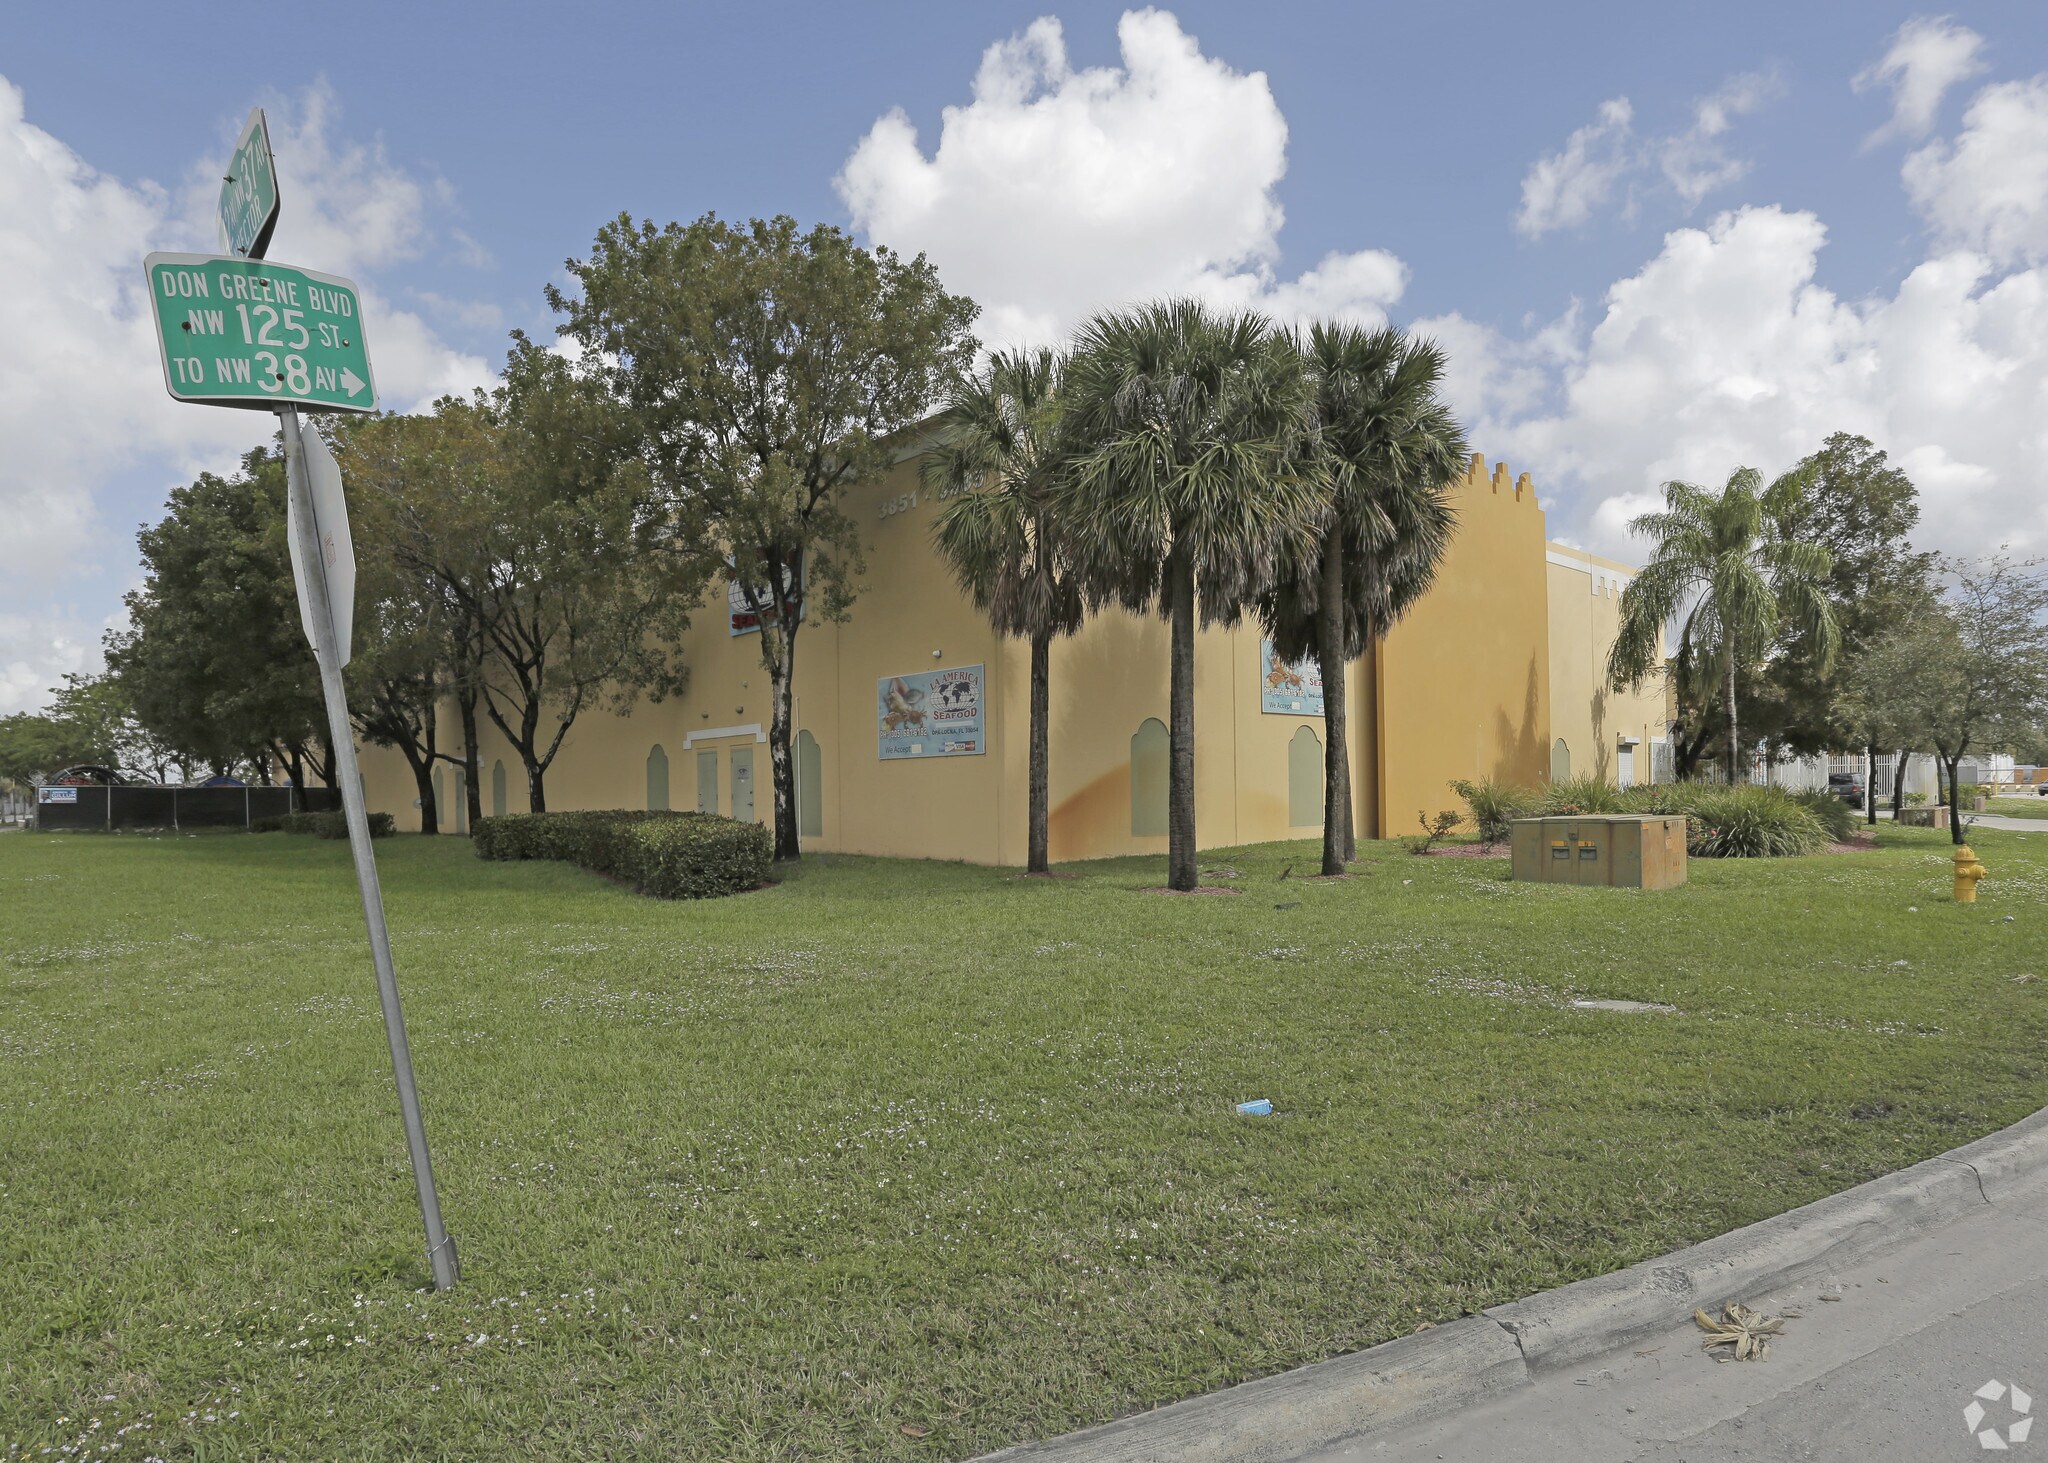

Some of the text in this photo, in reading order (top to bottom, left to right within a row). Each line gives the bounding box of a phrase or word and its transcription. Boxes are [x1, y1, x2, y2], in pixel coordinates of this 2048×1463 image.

[240, 140, 257, 202] 37
[255, 134, 265, 171] AV
[161, 271, 352, 317] DON GREENE BLVD
[188, 303, 340, 350] NW 125 ST
[173, 351, 336, 396] TO NW 38 AV
[878, 489, 917, 519] 3851
[930, 671, 979, 690] LA AMERICA
[933, 707, 977, 720] SEAFOOD
[1277, 702, 1292, 710] Accept
[894, 746, 912, 754] Accept
